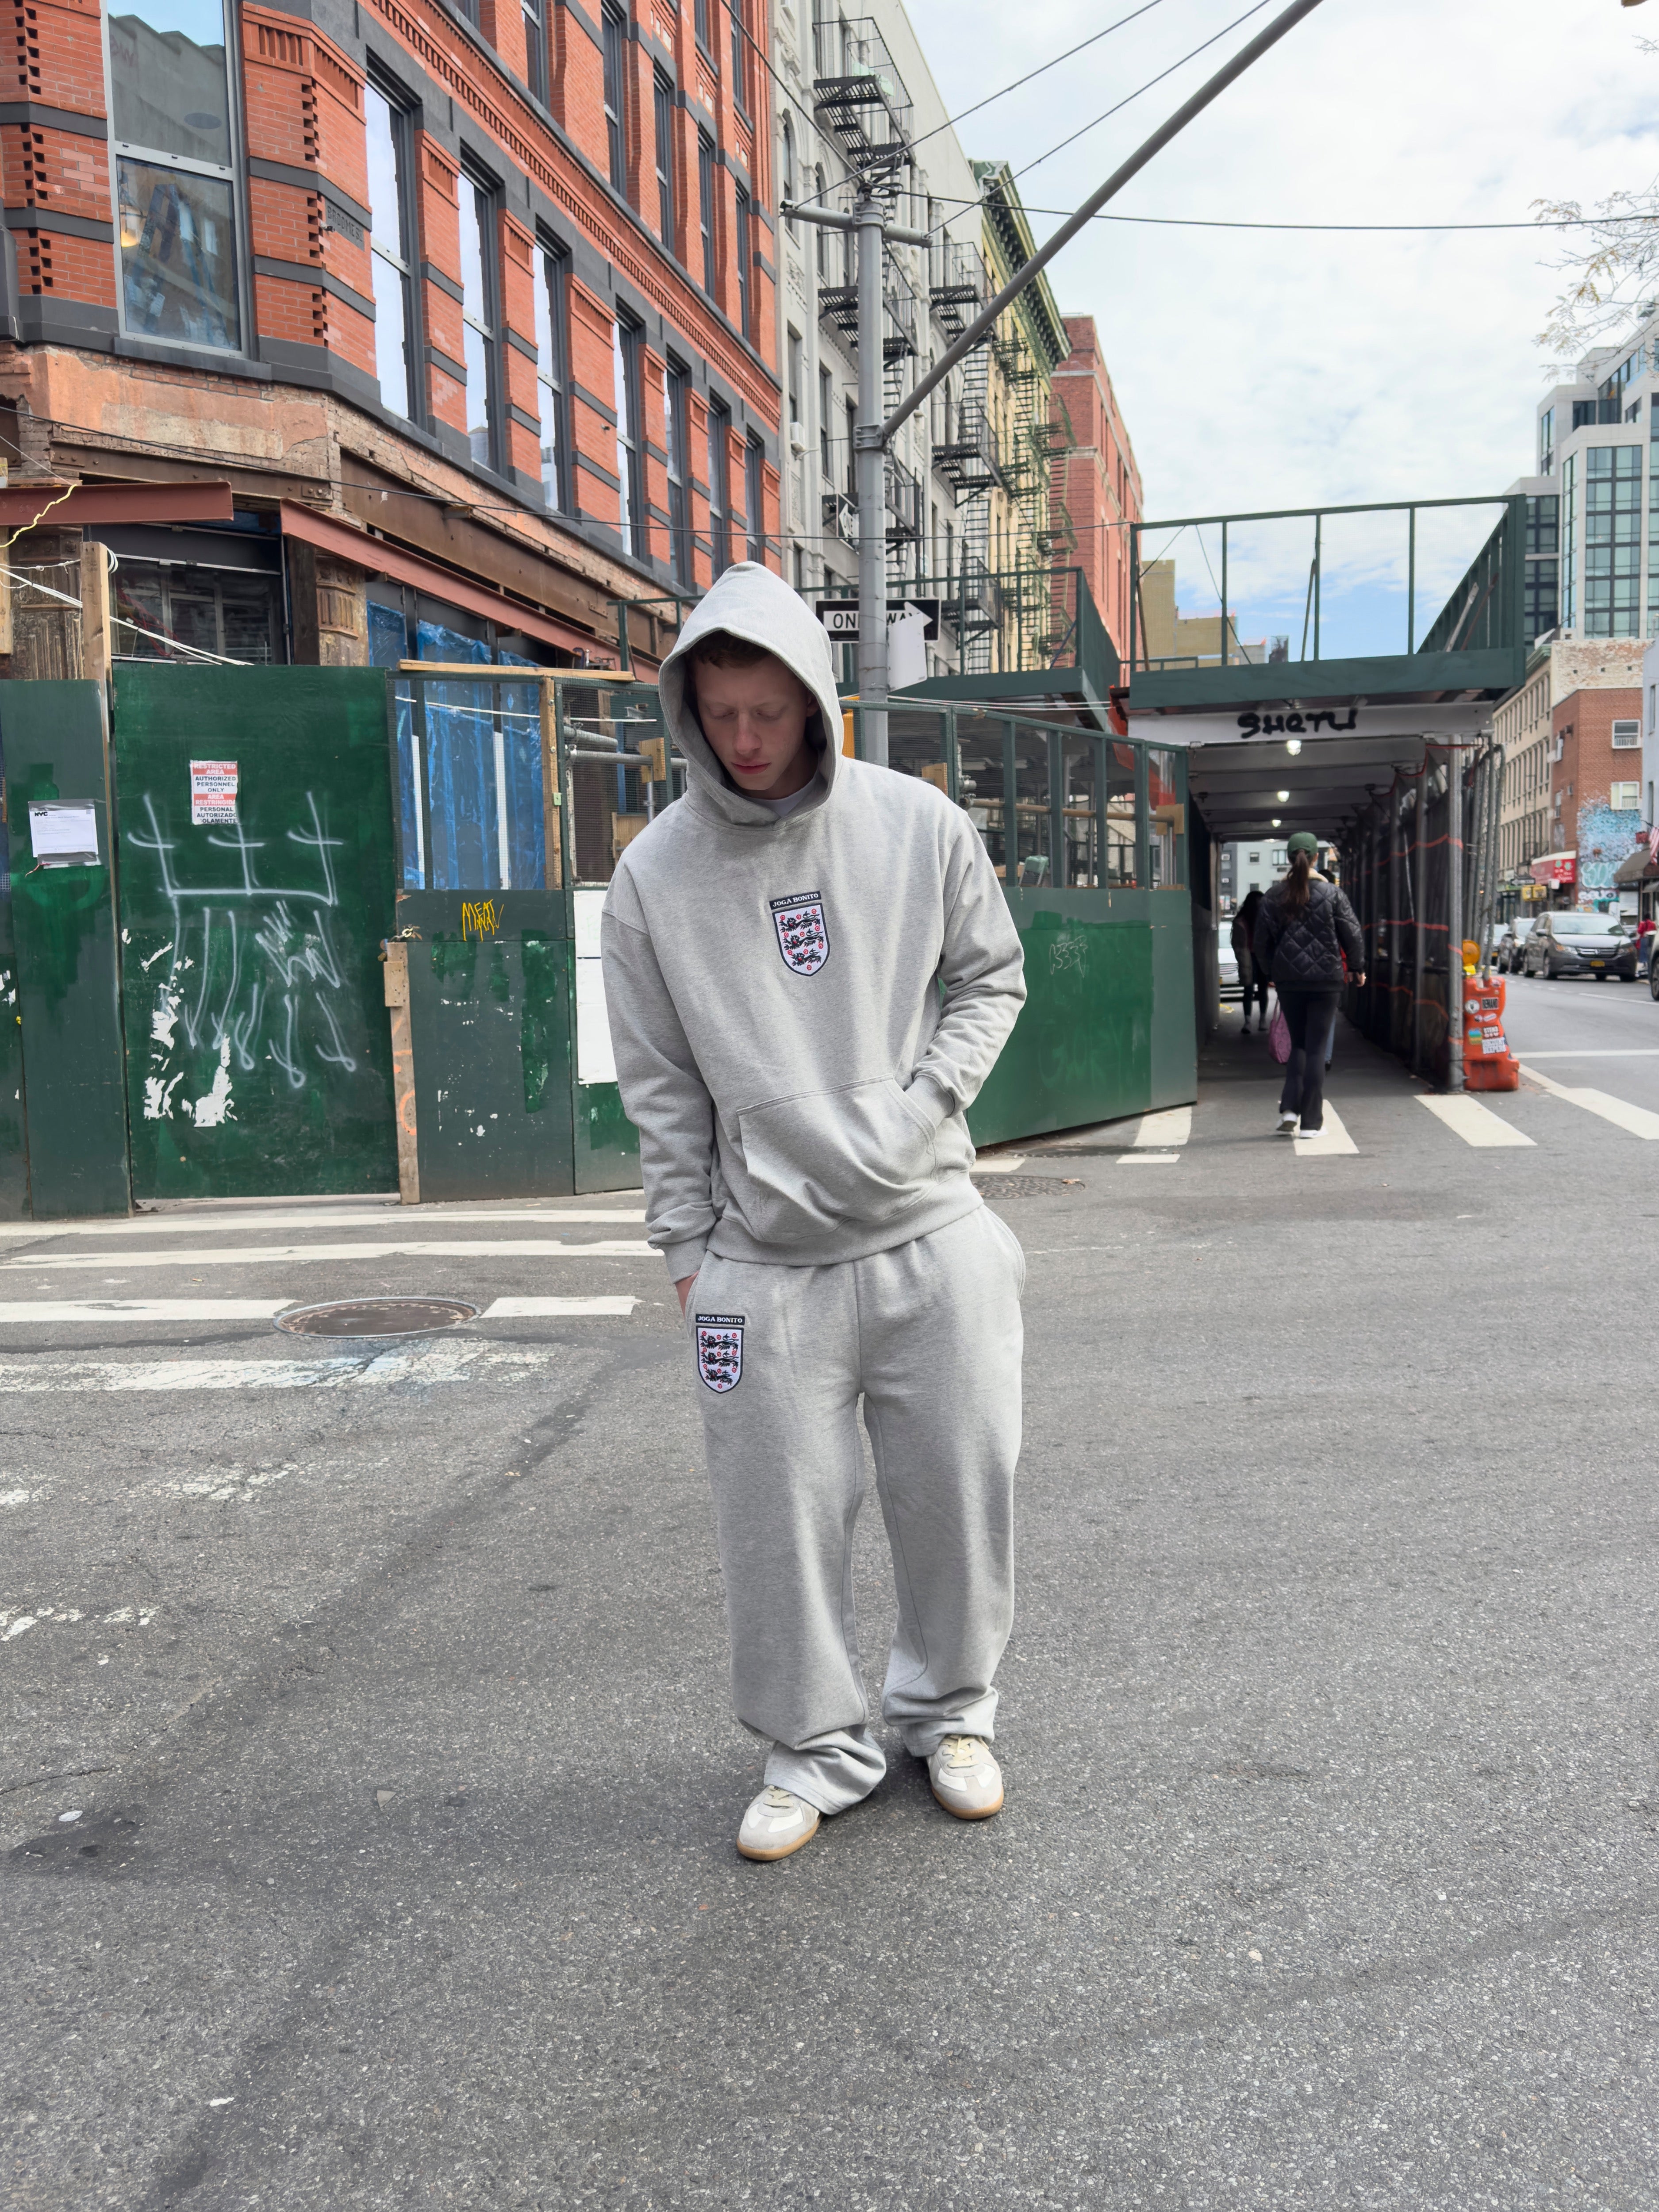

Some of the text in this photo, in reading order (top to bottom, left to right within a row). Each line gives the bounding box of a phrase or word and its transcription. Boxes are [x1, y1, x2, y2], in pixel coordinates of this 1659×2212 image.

[327, 206, 355, 237] BROOME
[833, 613, 859, 629] ON
[772, 893, 818, 907] JOGA BONITO
